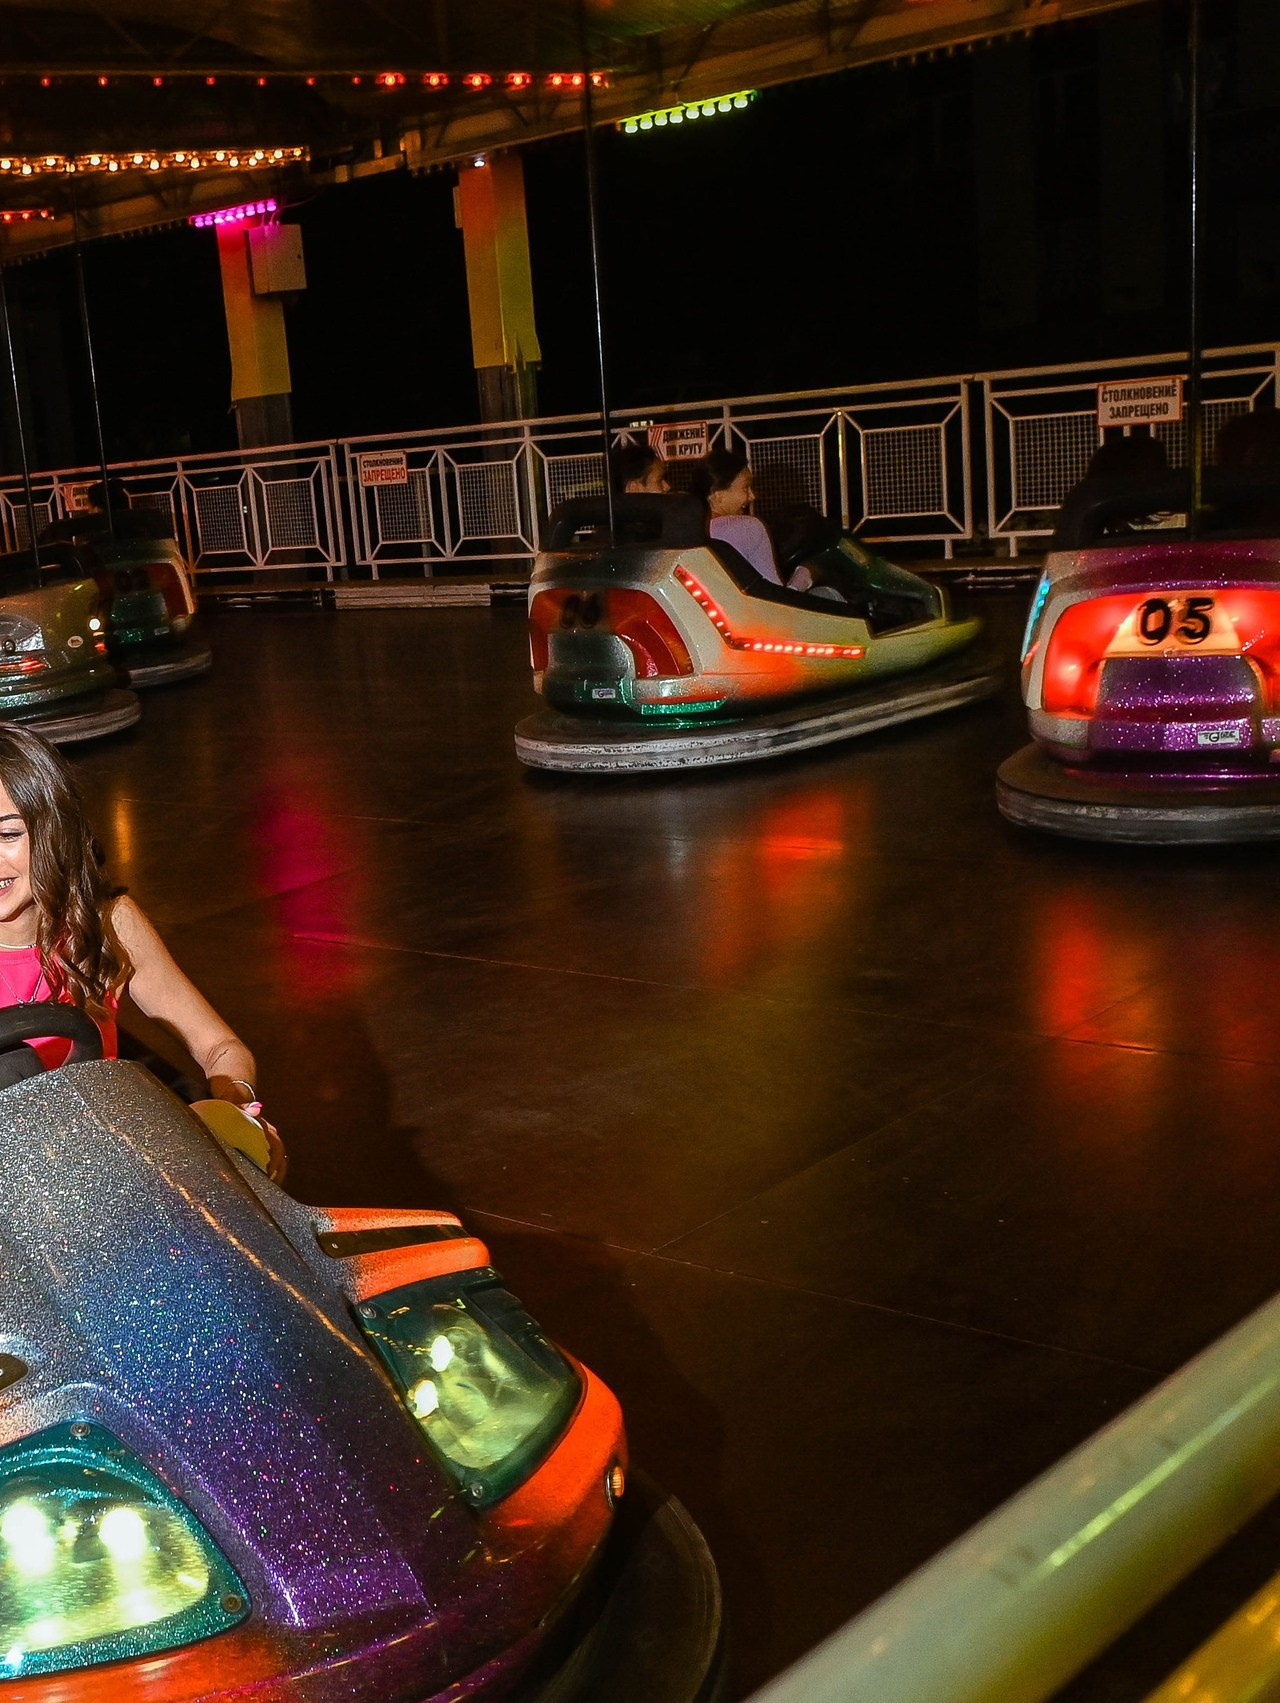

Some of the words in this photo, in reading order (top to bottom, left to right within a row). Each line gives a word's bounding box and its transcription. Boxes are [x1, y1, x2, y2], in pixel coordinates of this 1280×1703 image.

[1101, 384, 1177, 403] СТОЛКНОВЕНИЕ
[1109, 402, 1169, 420] ЗАПРЕЩЕНО
[678, 443, 703, 456] КРУГУ
[363, 467, 406, 482] ЗАПРЕЩЕНО
[1138, 597, 1215, 645] 05
